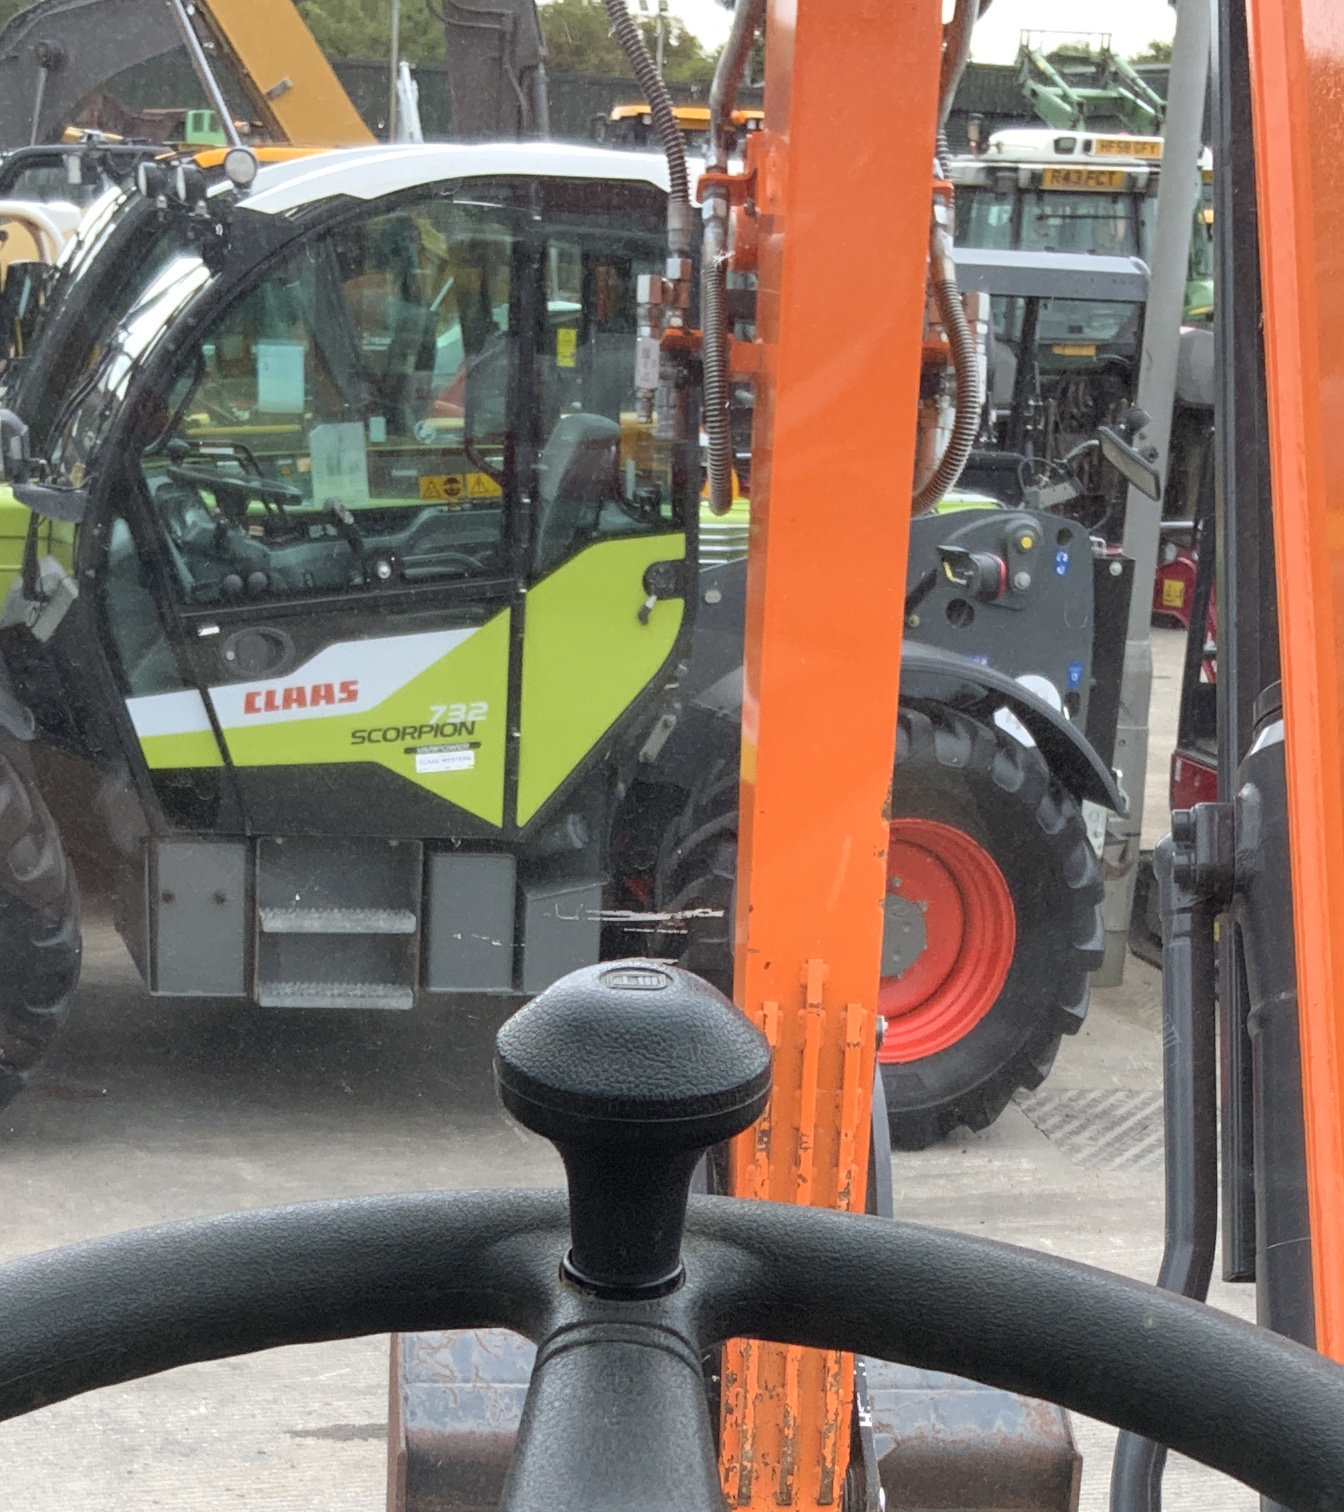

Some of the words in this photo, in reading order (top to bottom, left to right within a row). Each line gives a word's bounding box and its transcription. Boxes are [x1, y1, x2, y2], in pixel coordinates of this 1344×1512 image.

[244, 680, 359, 715] CLAAS
[429, 702, 489, 725] 732
[351, 721, 476, 745] SCORPION
